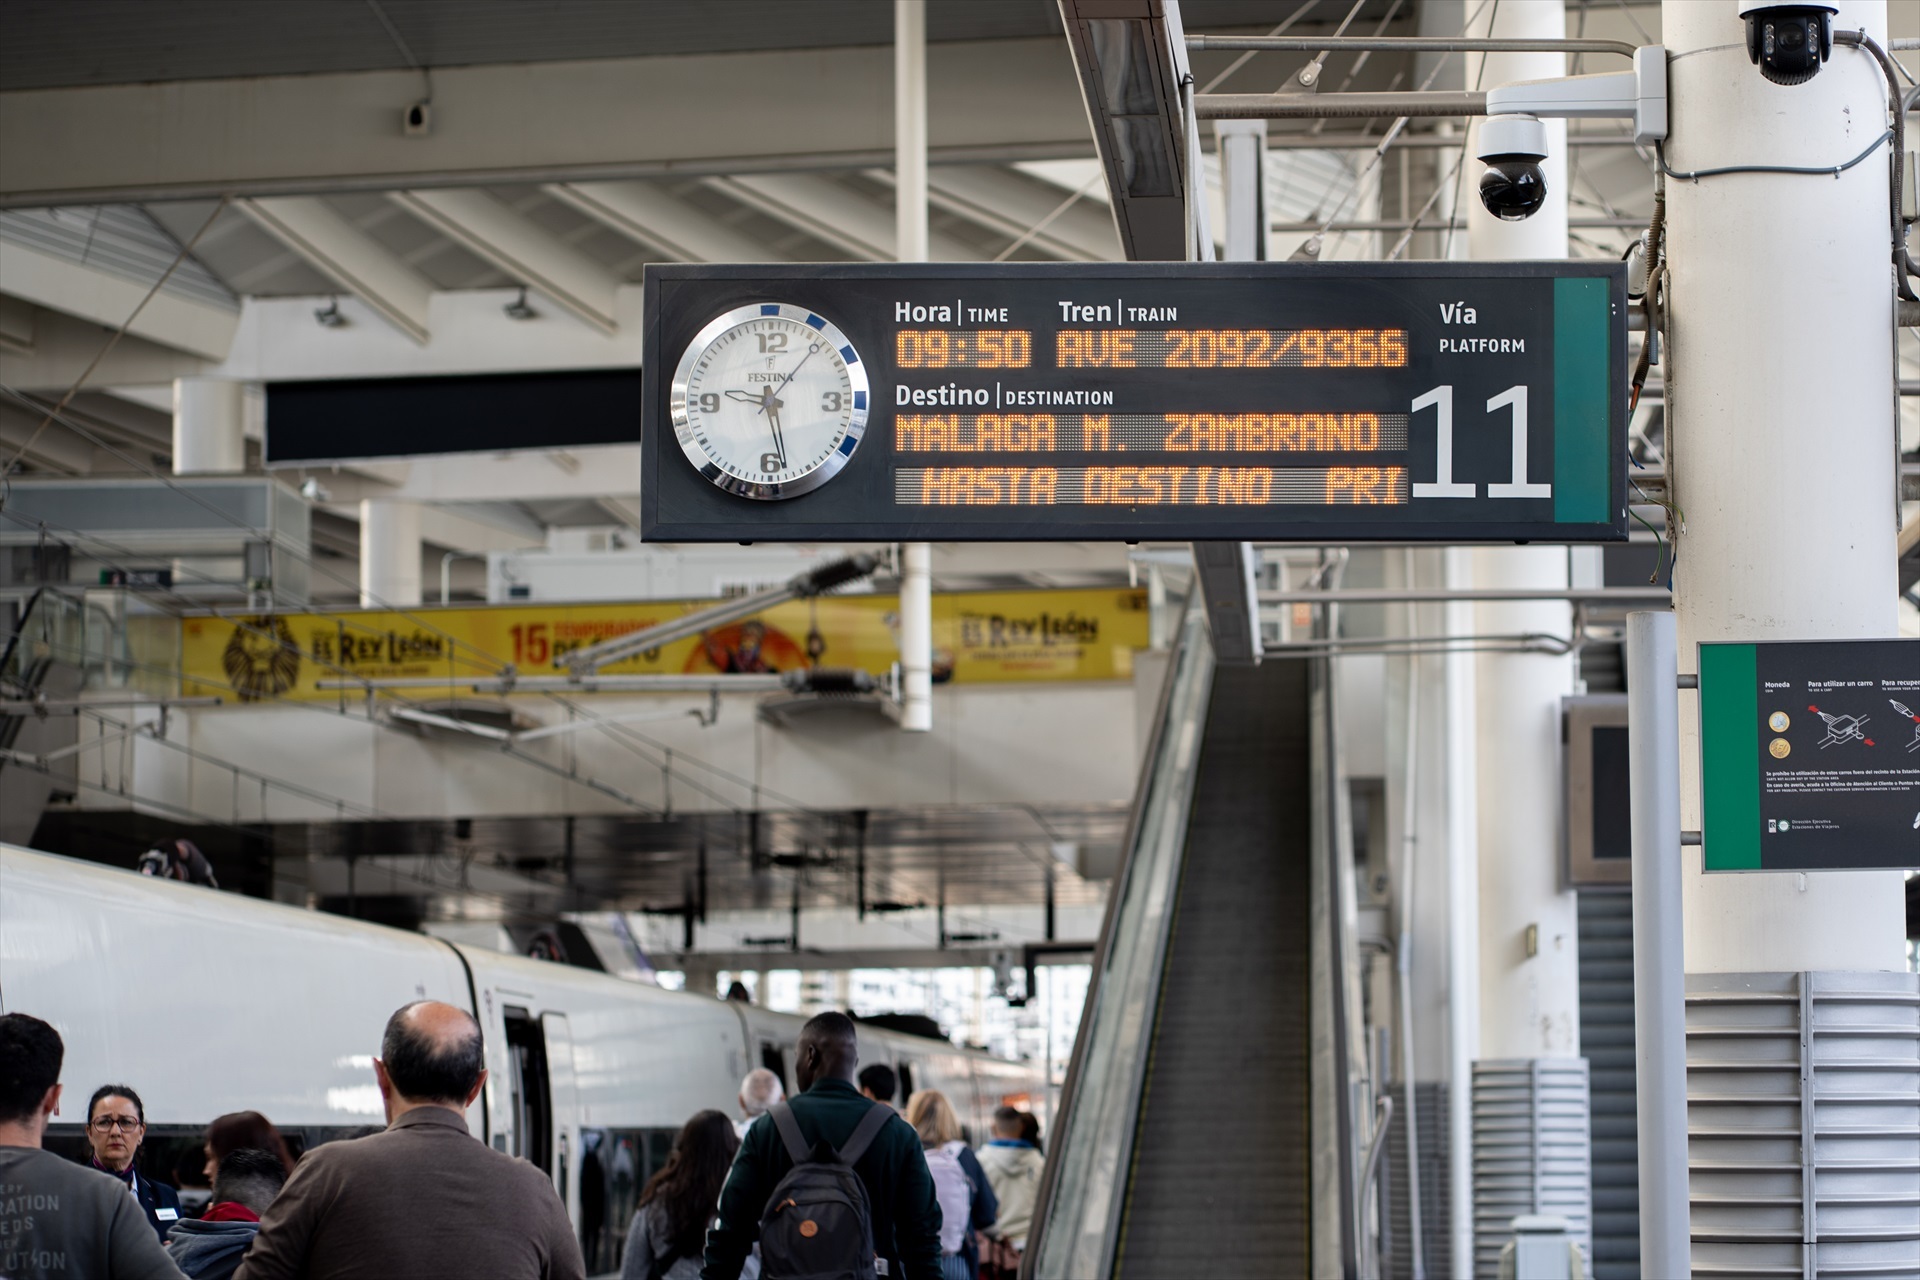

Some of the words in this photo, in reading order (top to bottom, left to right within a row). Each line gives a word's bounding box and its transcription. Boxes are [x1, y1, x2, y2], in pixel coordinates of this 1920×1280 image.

[895, 301, 951, 322] Hora
[968, 308, 1008, 322] TIME
[1058, 301, 1112, 322] Tren
[1128, 307, 1177, 322] TRAIN
[1439, 301, 1477, 324] Vía
[754, 332, 788, 353] 12
[897, 330, 1029, 368] 09:50
[1057, 330, 1136, 368] AVE
[1165, 330, 1405, 368] 2092/9366
[1439, 338, 1525, 353] PLATFORM
[748, 373, 794, 382] FESTINA
[700, 393, 720, 414] 9
[822, 392, 842, 412] 3
[896, 383, 990, 406] Destino
[1006, 390, 1114, 405] DESTINATION
[1084, 414, 1126, 451] M.
[1164, 414, 1378, 451] ZAMBRANO
[1412, 386, 1551, 498] 11
[760, 453, 780, 474] 6
[922, 467, 1058, 504] HASTA
[1084, 467, 1273, 504] DESTINO
[1326, 467, 1402, 504] PRI
[509, 624, 549, 667] 15
